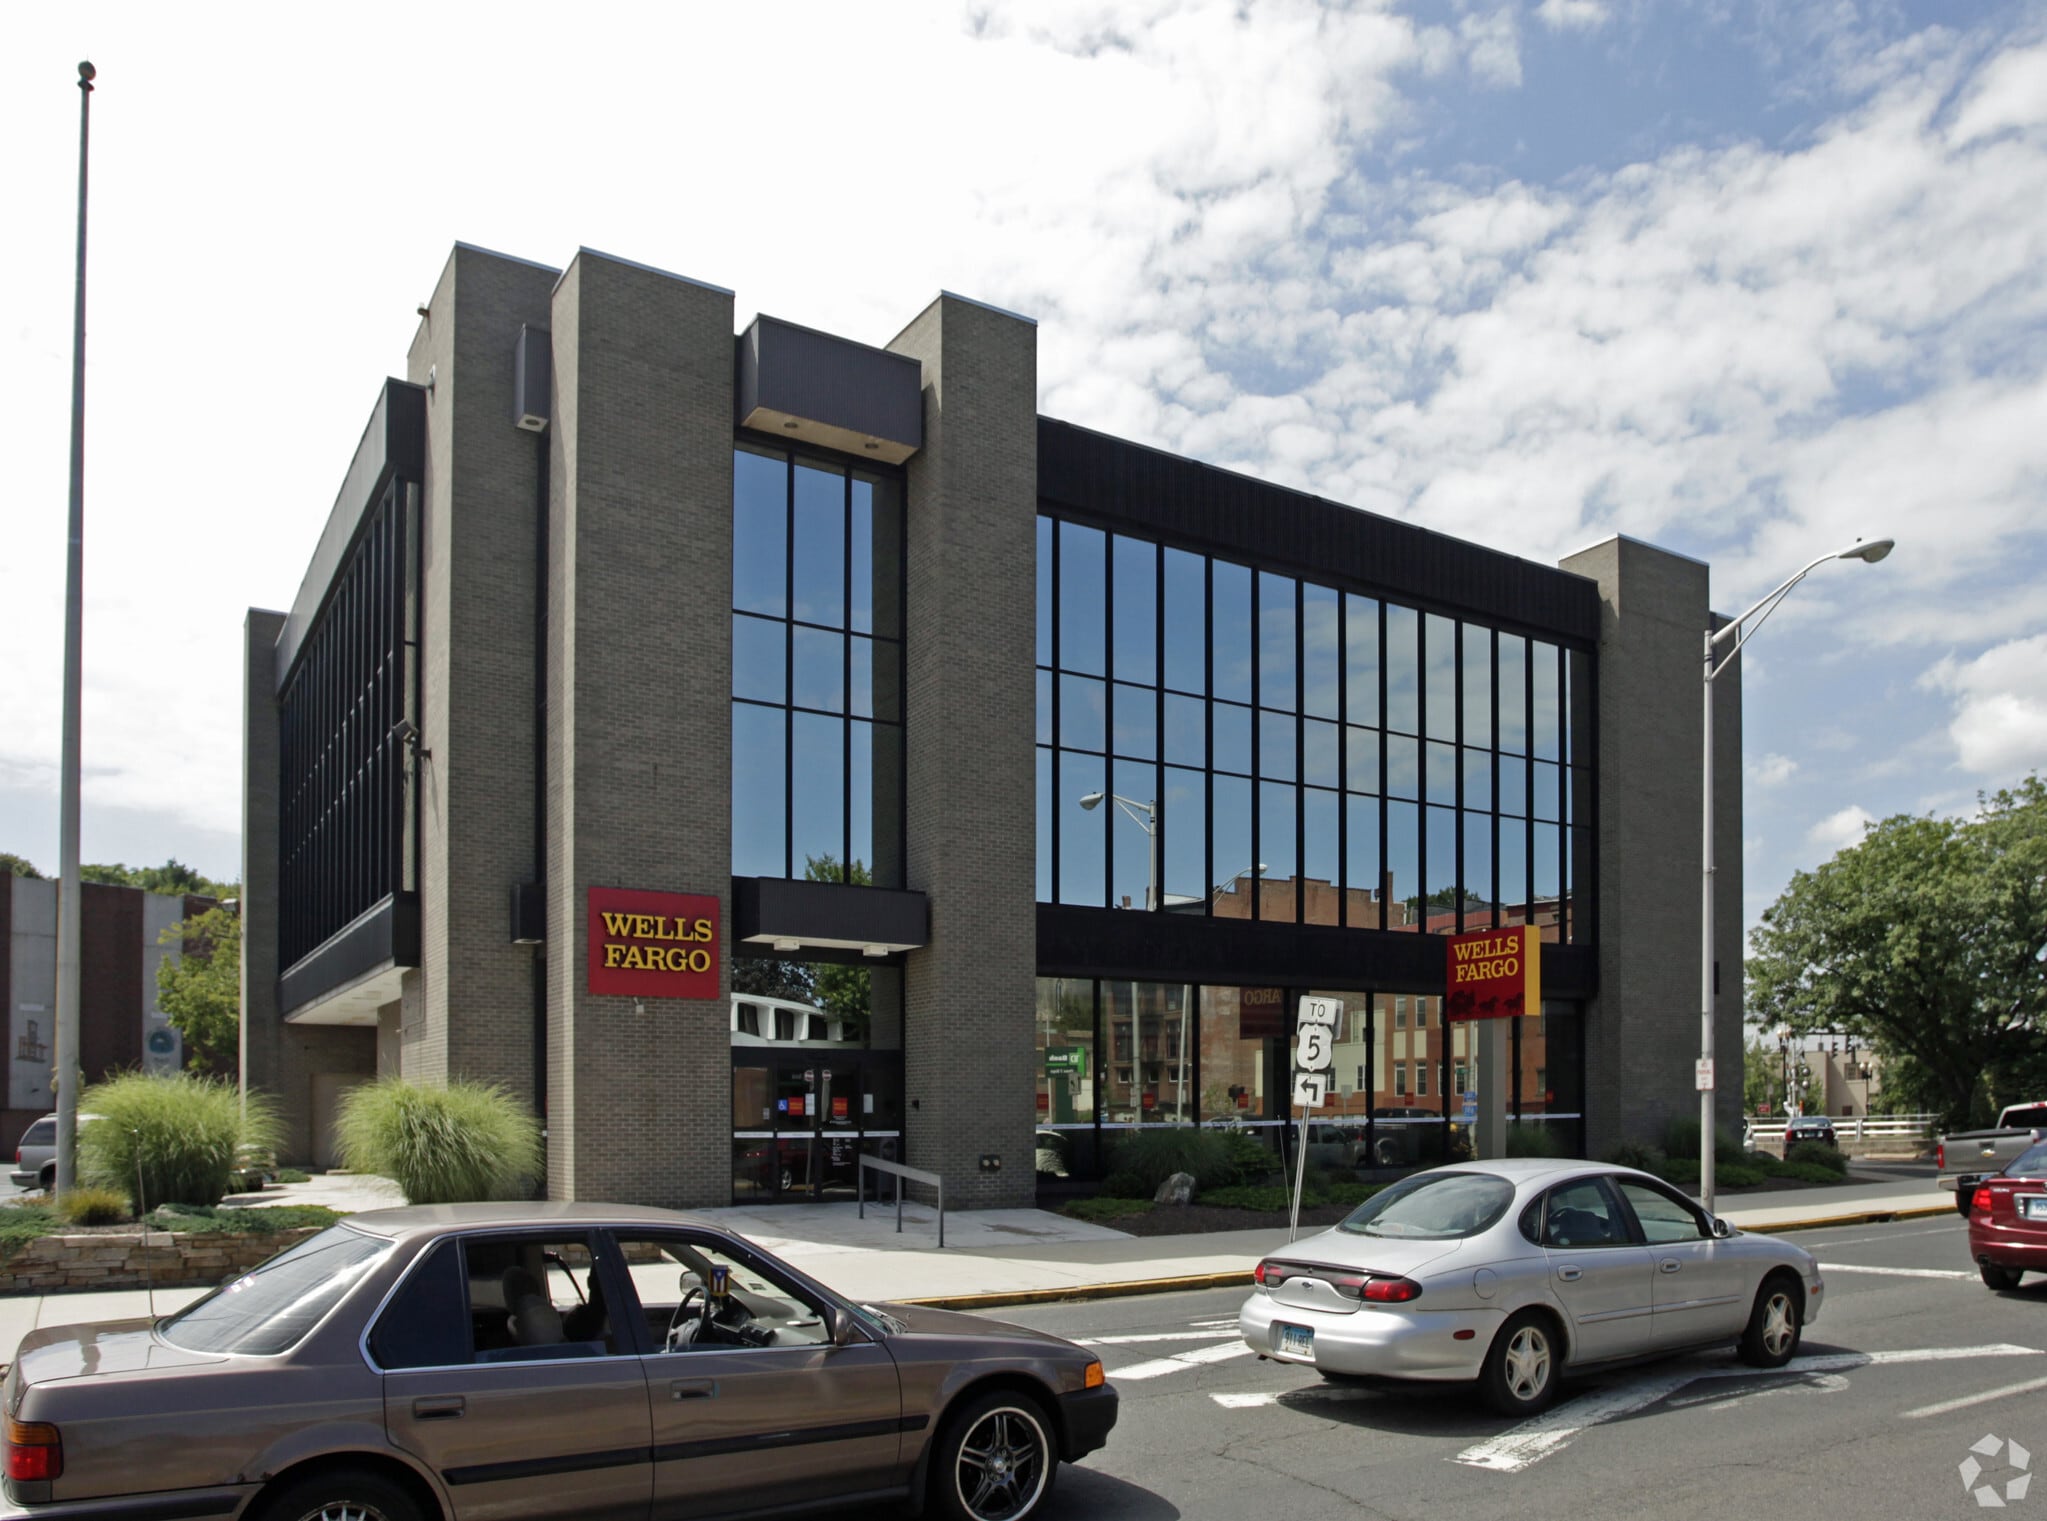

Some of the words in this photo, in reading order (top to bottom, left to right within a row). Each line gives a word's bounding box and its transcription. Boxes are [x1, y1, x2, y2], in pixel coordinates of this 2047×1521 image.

[601, 911, 713, 943] WELLS
[603, 943, 711, 973] FARGO
[1453, 935, 1520, 961] WELLS
[1455, 957, 1519, 983] FARGO
[1310, 1002, 1326, 1018] TO
[1307, 1034, 1321, 1061] 5
